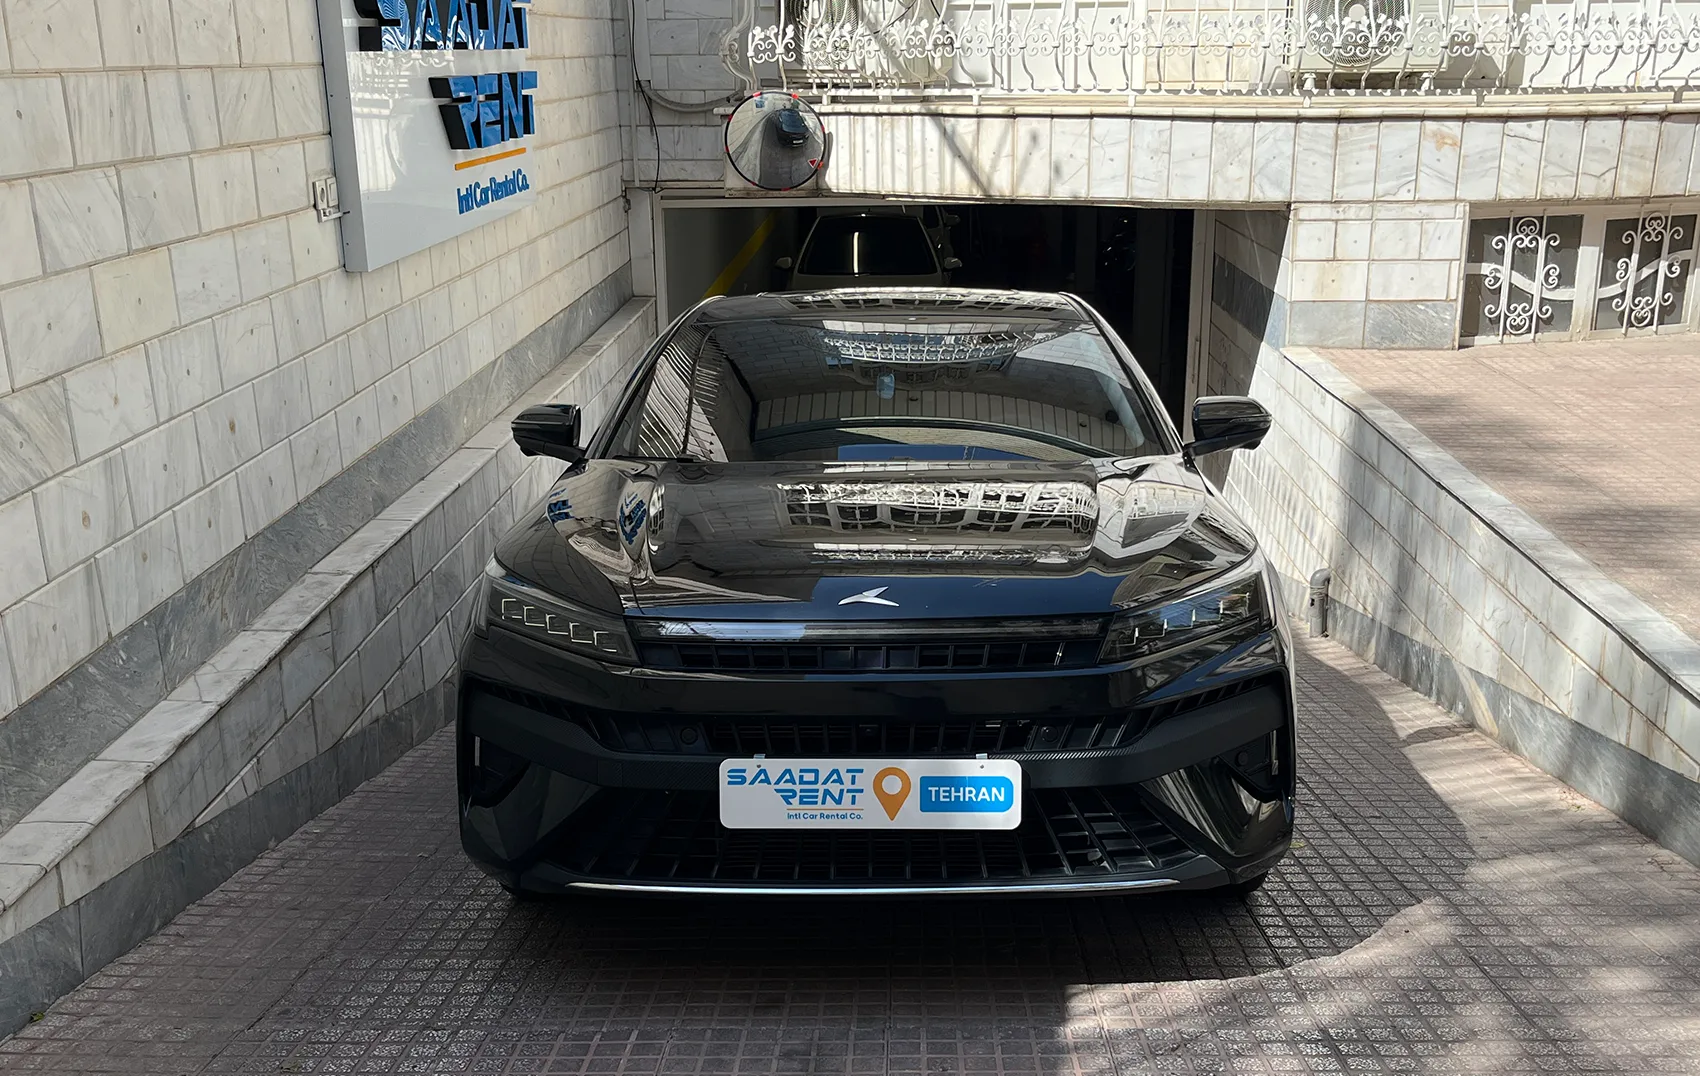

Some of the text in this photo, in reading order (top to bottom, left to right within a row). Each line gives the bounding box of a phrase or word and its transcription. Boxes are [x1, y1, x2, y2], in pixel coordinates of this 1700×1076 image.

[430, 71, 538, 149] RENT
[457, 168, 530, 215] Intl Car Rental Co.
[727, 768, 864, 785] SAADAT
[773, 788, 864, 805] RENT
[928, 786, 1005, 802] TEHRAN
[787, 812, 864, 820] Intl Car Rental Co.
